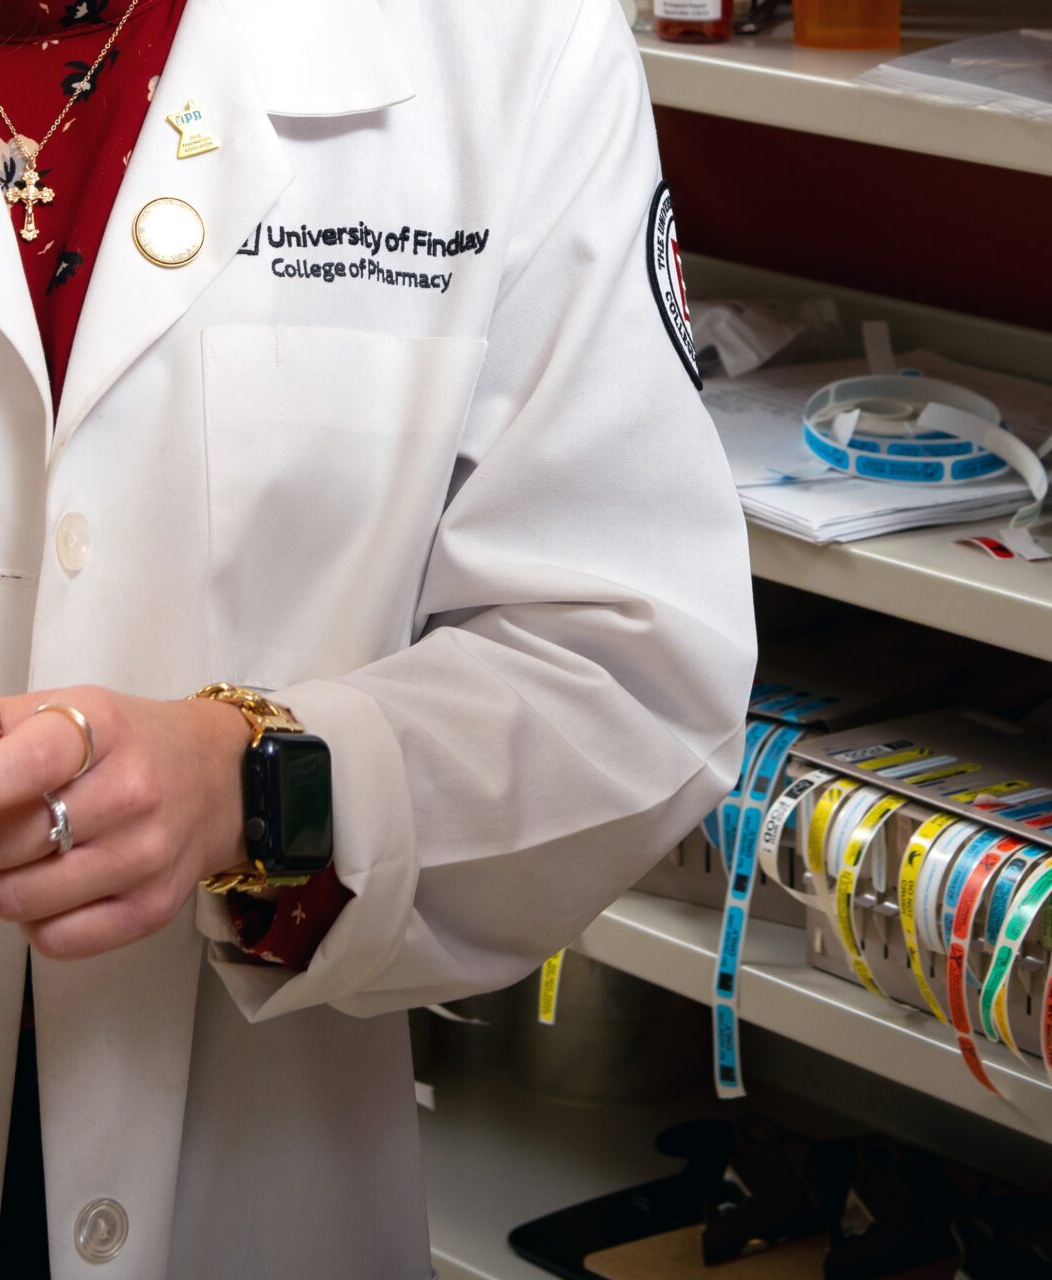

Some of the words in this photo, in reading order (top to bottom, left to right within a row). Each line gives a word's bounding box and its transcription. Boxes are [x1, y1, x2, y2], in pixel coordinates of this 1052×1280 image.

[267, 221, 382, 256] University
[385, 226, 410, 252] of
[413, 228, 489, 257] Findlay
[657, 235, 666, 270] THE
[271, 258, 347, 283] College
[349, 258, 366, 278] of
[367, 259, 453, 293] Pharmacy
[908, 880, 915, 895] DO
[906, 897, 914, 919] NOT
